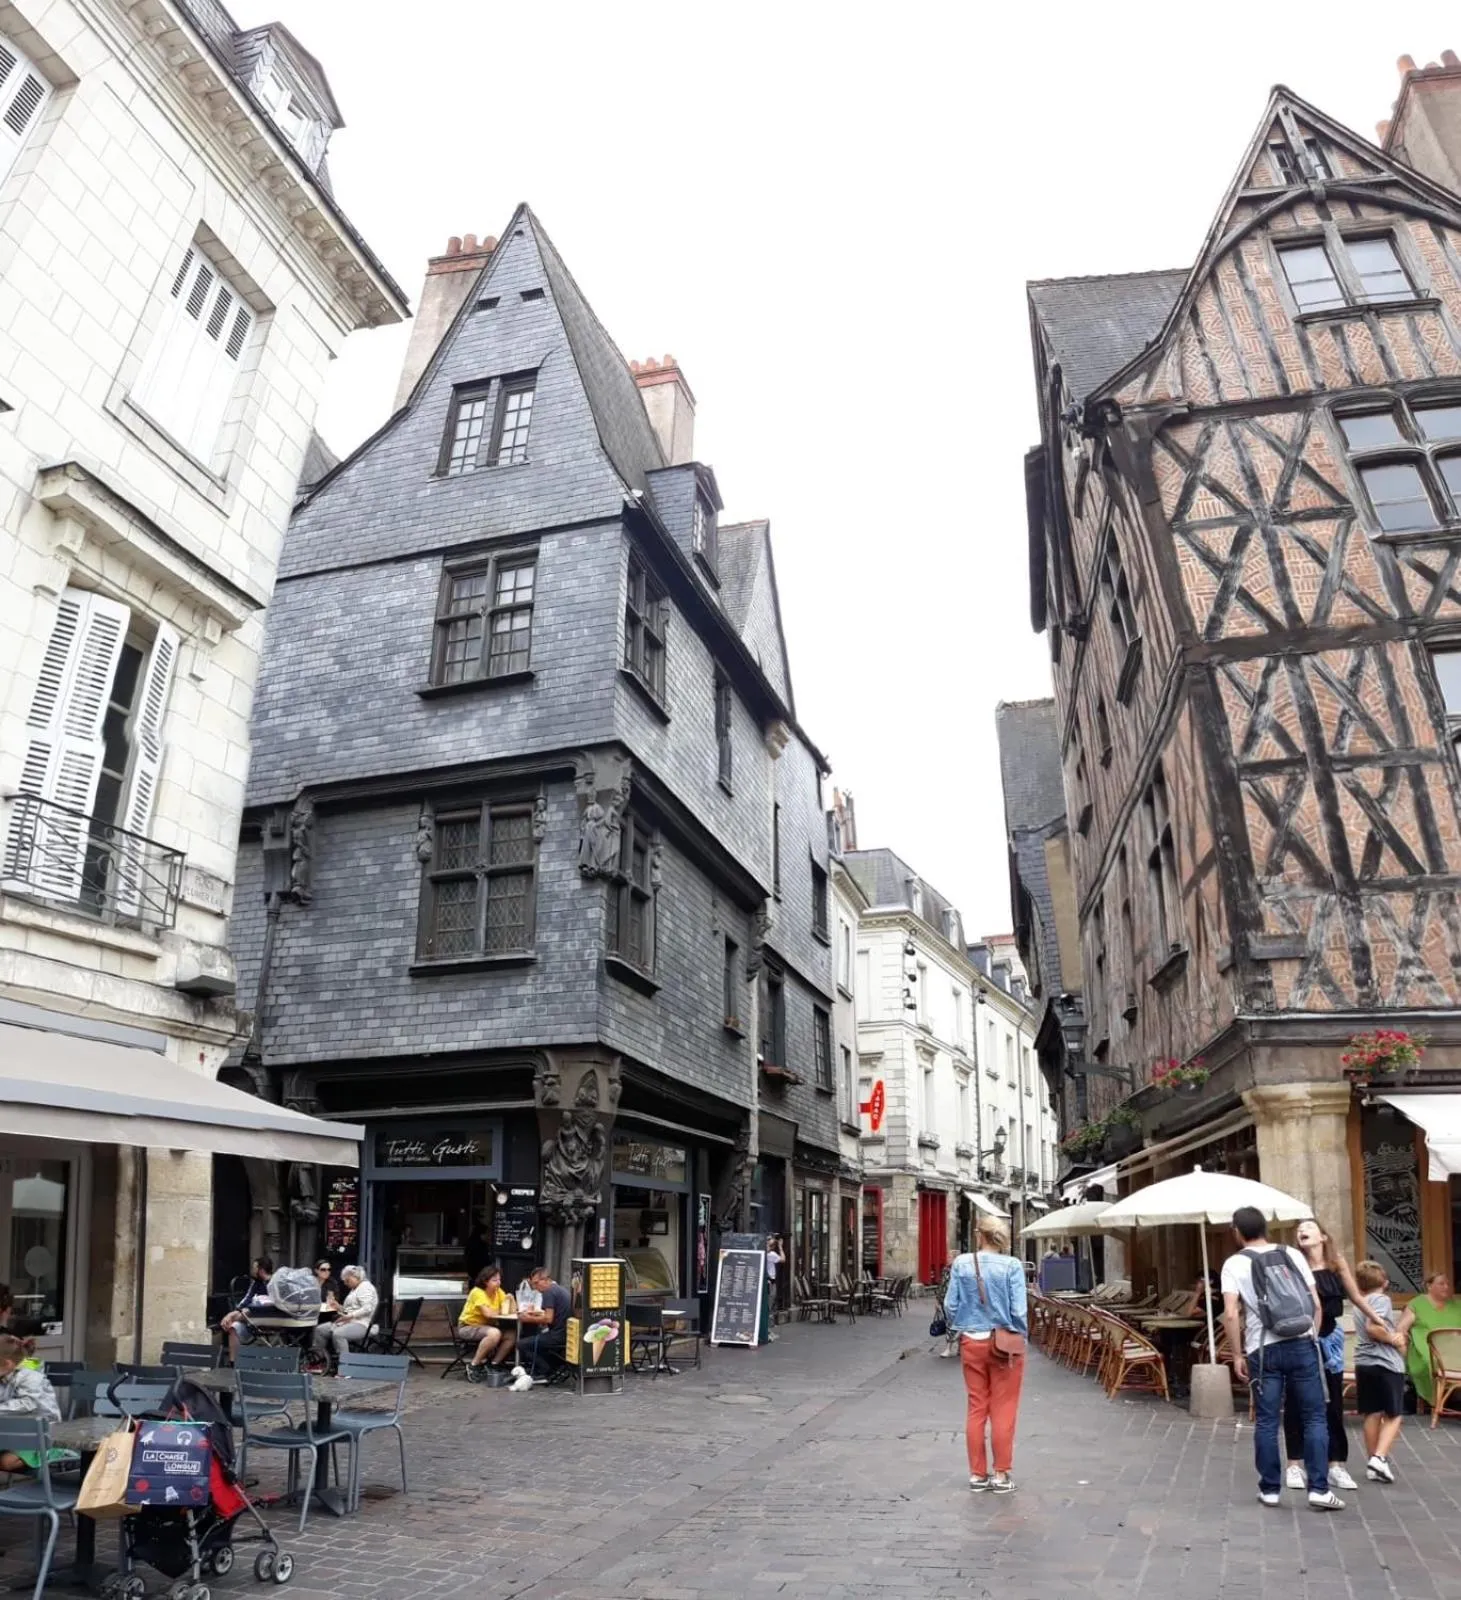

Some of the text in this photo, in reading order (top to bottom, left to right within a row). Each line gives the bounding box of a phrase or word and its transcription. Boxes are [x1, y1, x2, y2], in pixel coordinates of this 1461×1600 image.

[872, 1088, 881, 1119] TABAC
[386, 1138, 480, 1163] Tutti Gusti
[159, 1453, 185, 1461] CHAISE
[167, 1463, 198, 1471] LONGUE
